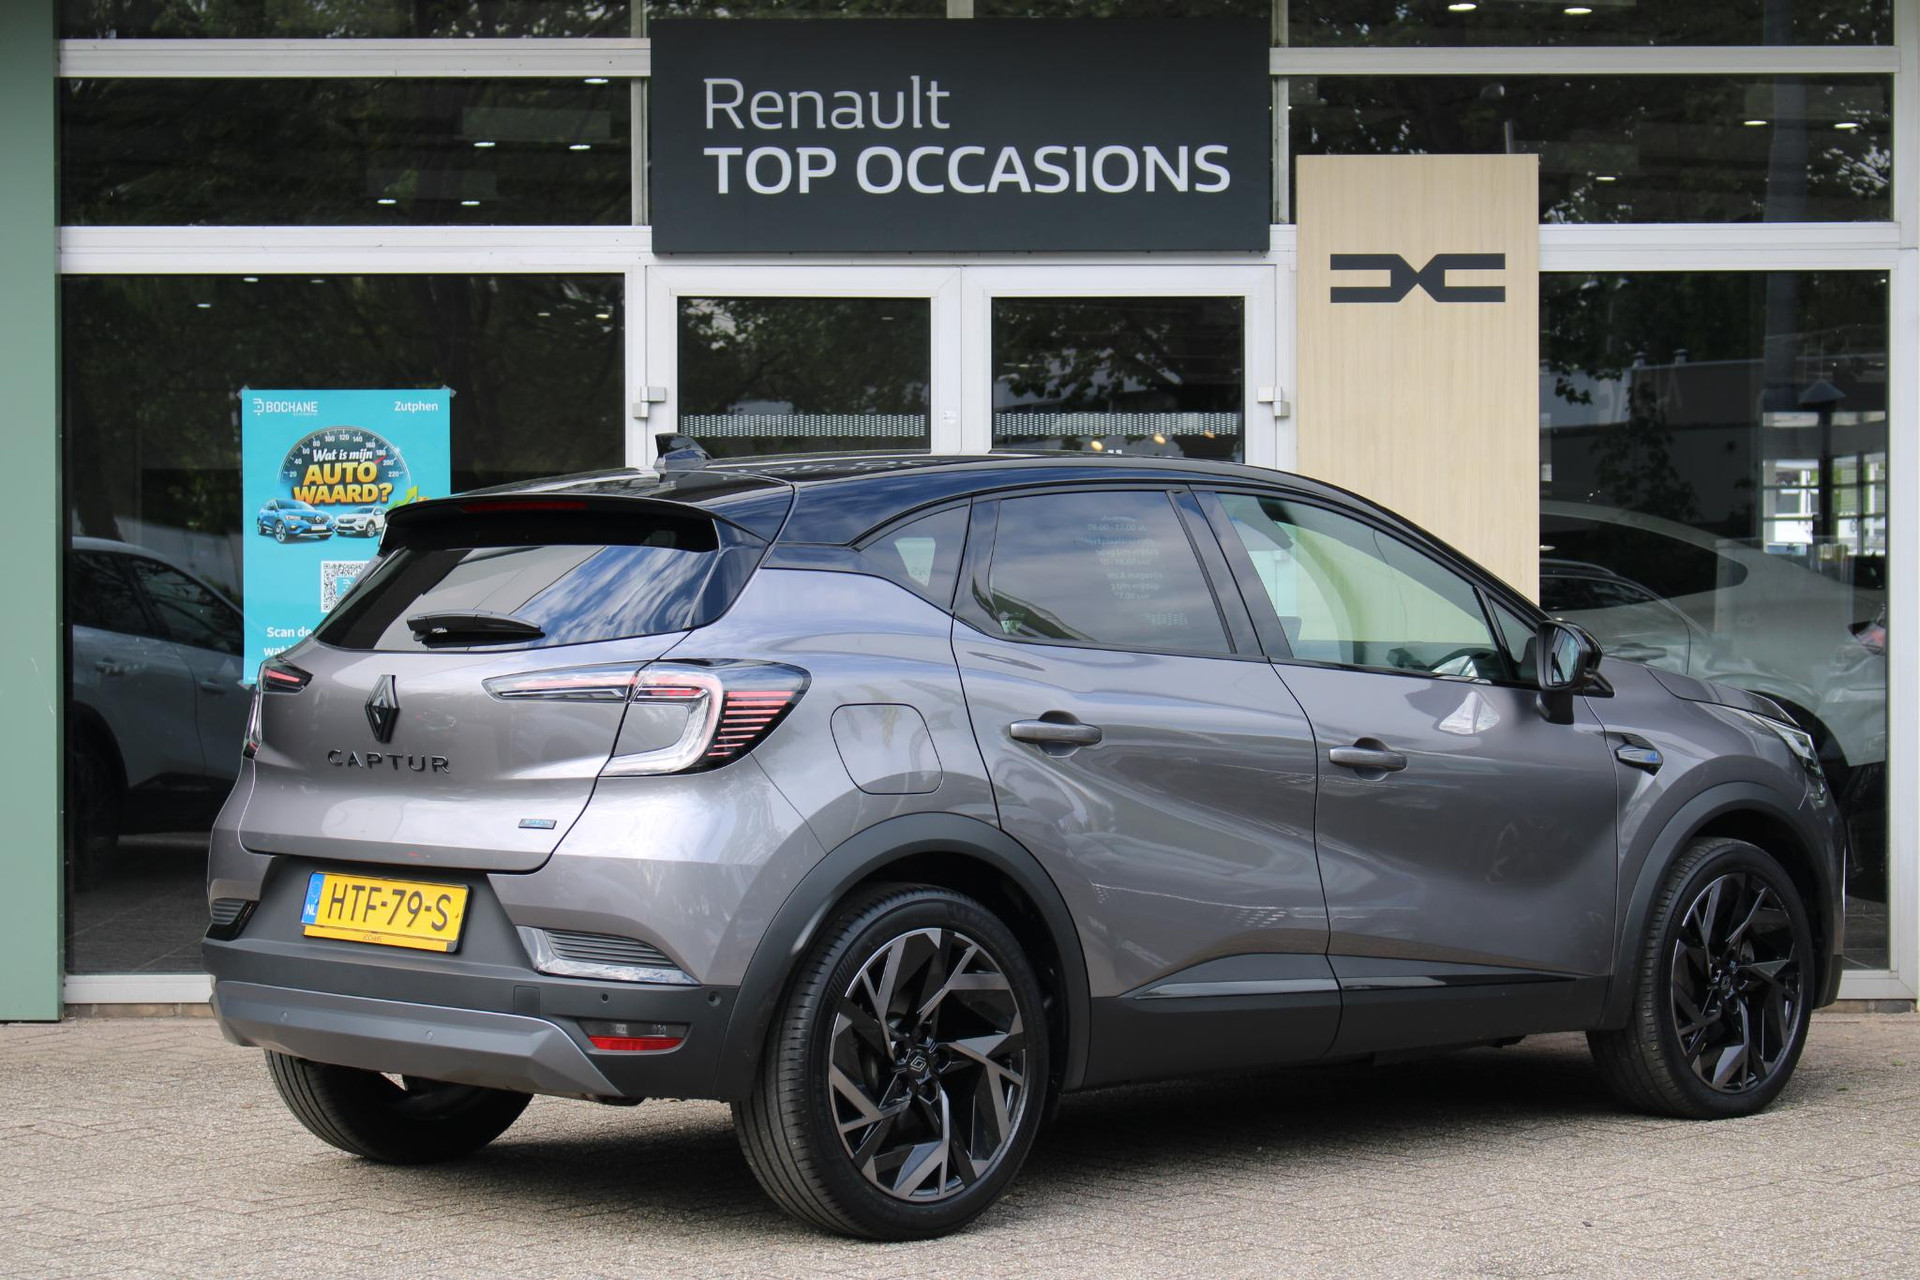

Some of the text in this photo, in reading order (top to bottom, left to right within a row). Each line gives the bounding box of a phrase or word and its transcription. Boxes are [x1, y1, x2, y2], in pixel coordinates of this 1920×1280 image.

[703, 76, 951, 130] Renault
[703, 145, 1231, 195] TOP OCCASIONS
[266, 401, 318, 412] BOCHANE
[394, 400, 438, 412] Zutphen
[313, 448, 373, 462] Wat is mijn
[302, 461, 378, 486] AUTO
[293, 482, 393, 504] WAARD?
[266, 626, 312, 638] Scan de
[263, 646, 287, 657] wat
[328, 750, 450, 773] CAPTUR
[305, 904, 316, 916] NL
[327, 882, 452, 932] HTF-79-S
